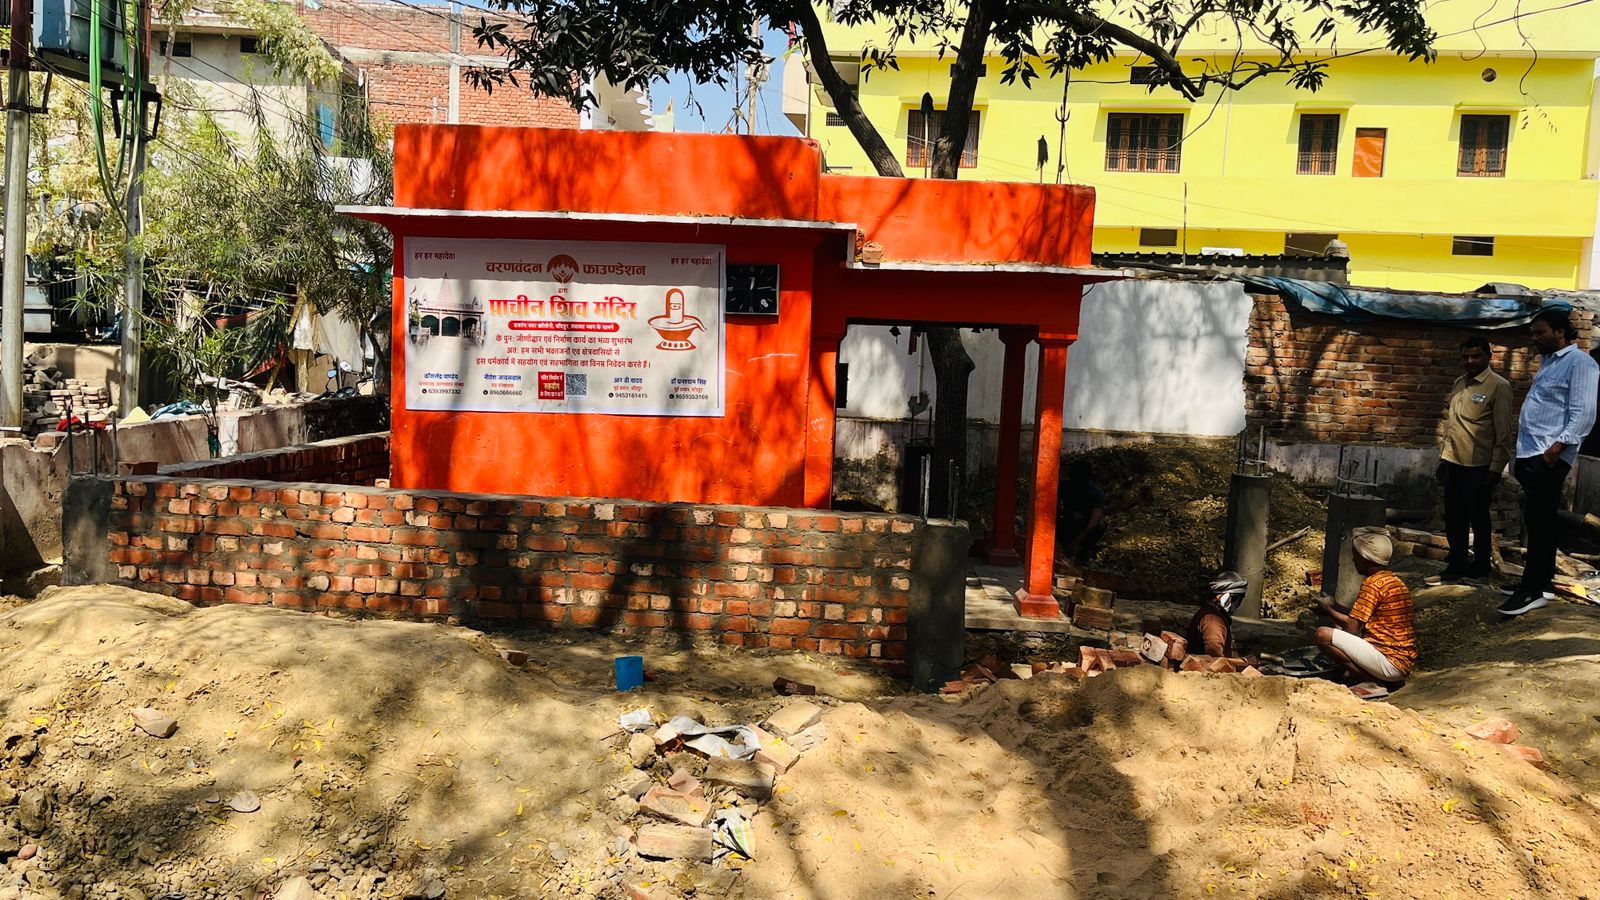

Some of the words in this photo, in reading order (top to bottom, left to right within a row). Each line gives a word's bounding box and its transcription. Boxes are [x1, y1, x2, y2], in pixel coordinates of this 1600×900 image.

[486, 260, 543, 273] चरणवंदन
[583, 263, 647, 276] फाउण्डेशन
[489, 295, 544, 317] प्राचीन
[549, 295, 588, 319] शिव
[593, 297, 637, 320] मंदिर
[517, 358, 538, 366] सहयोग
